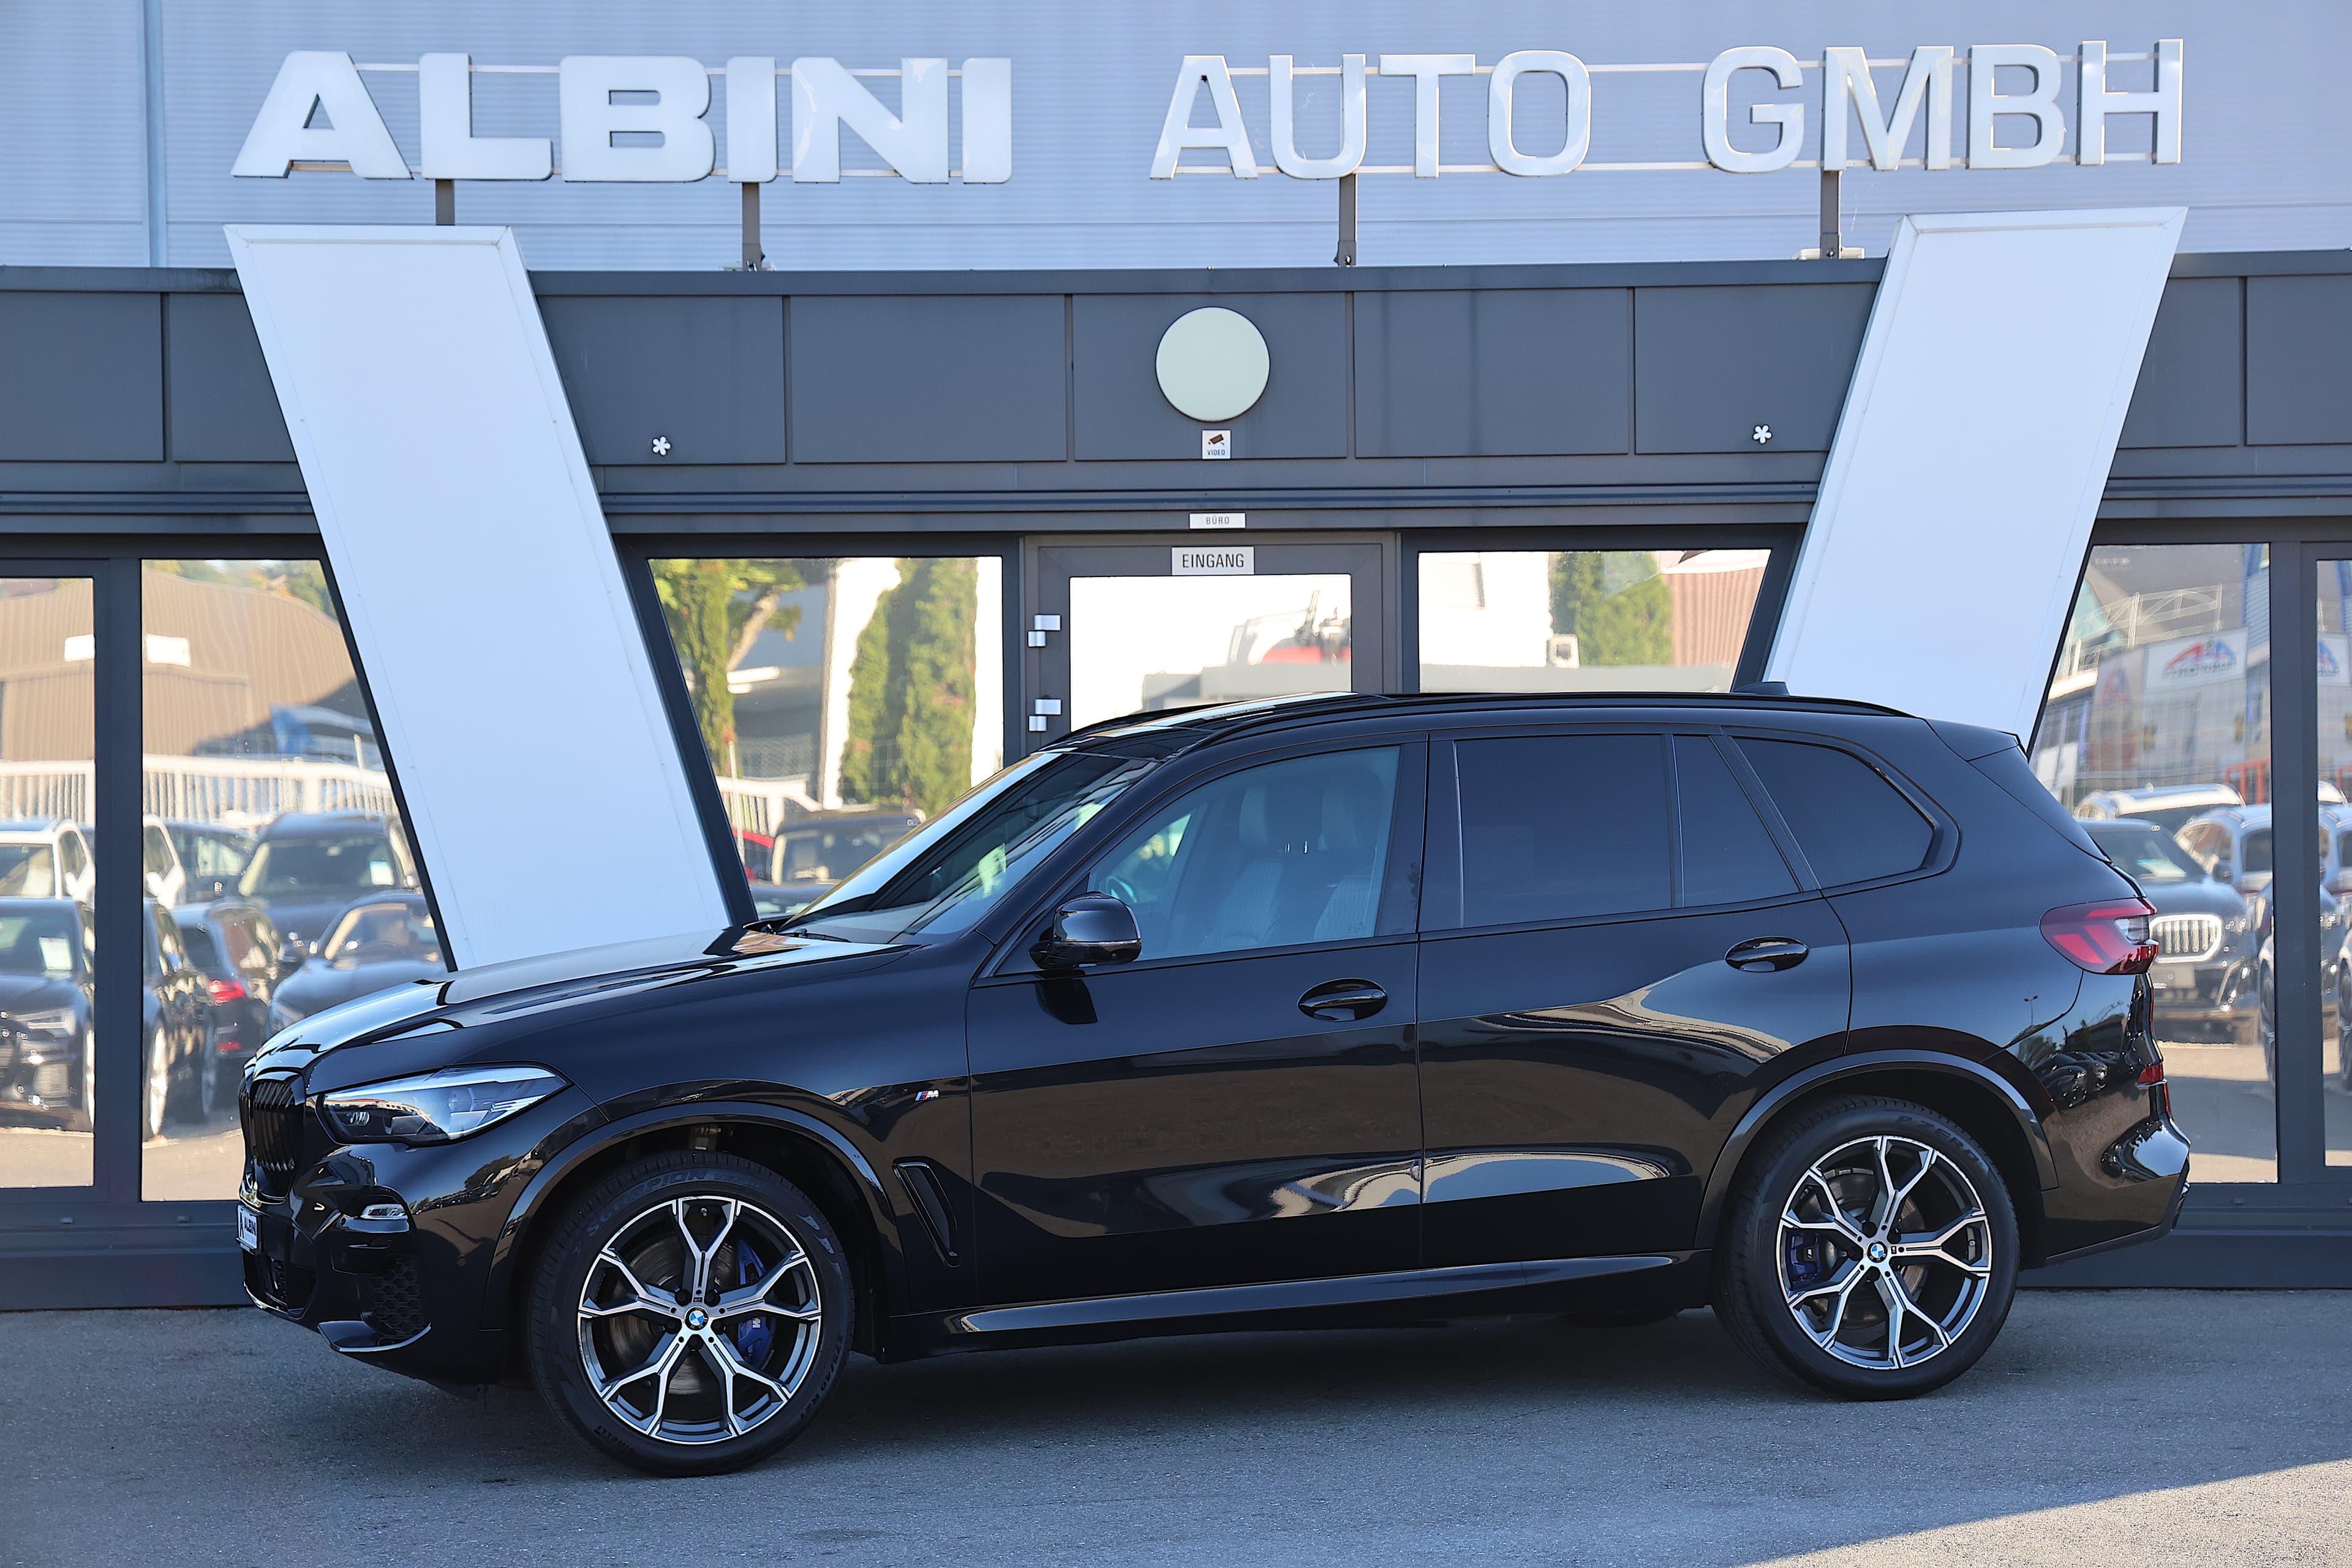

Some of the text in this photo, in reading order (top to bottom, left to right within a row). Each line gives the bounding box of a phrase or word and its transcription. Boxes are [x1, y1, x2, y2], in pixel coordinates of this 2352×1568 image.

[230, 38, 2184, 184] ALBINI AUTO GMBH
[1205, 515, 1230, 525] BÜRO
[1182, 553, 1245, 568] EINGANG
